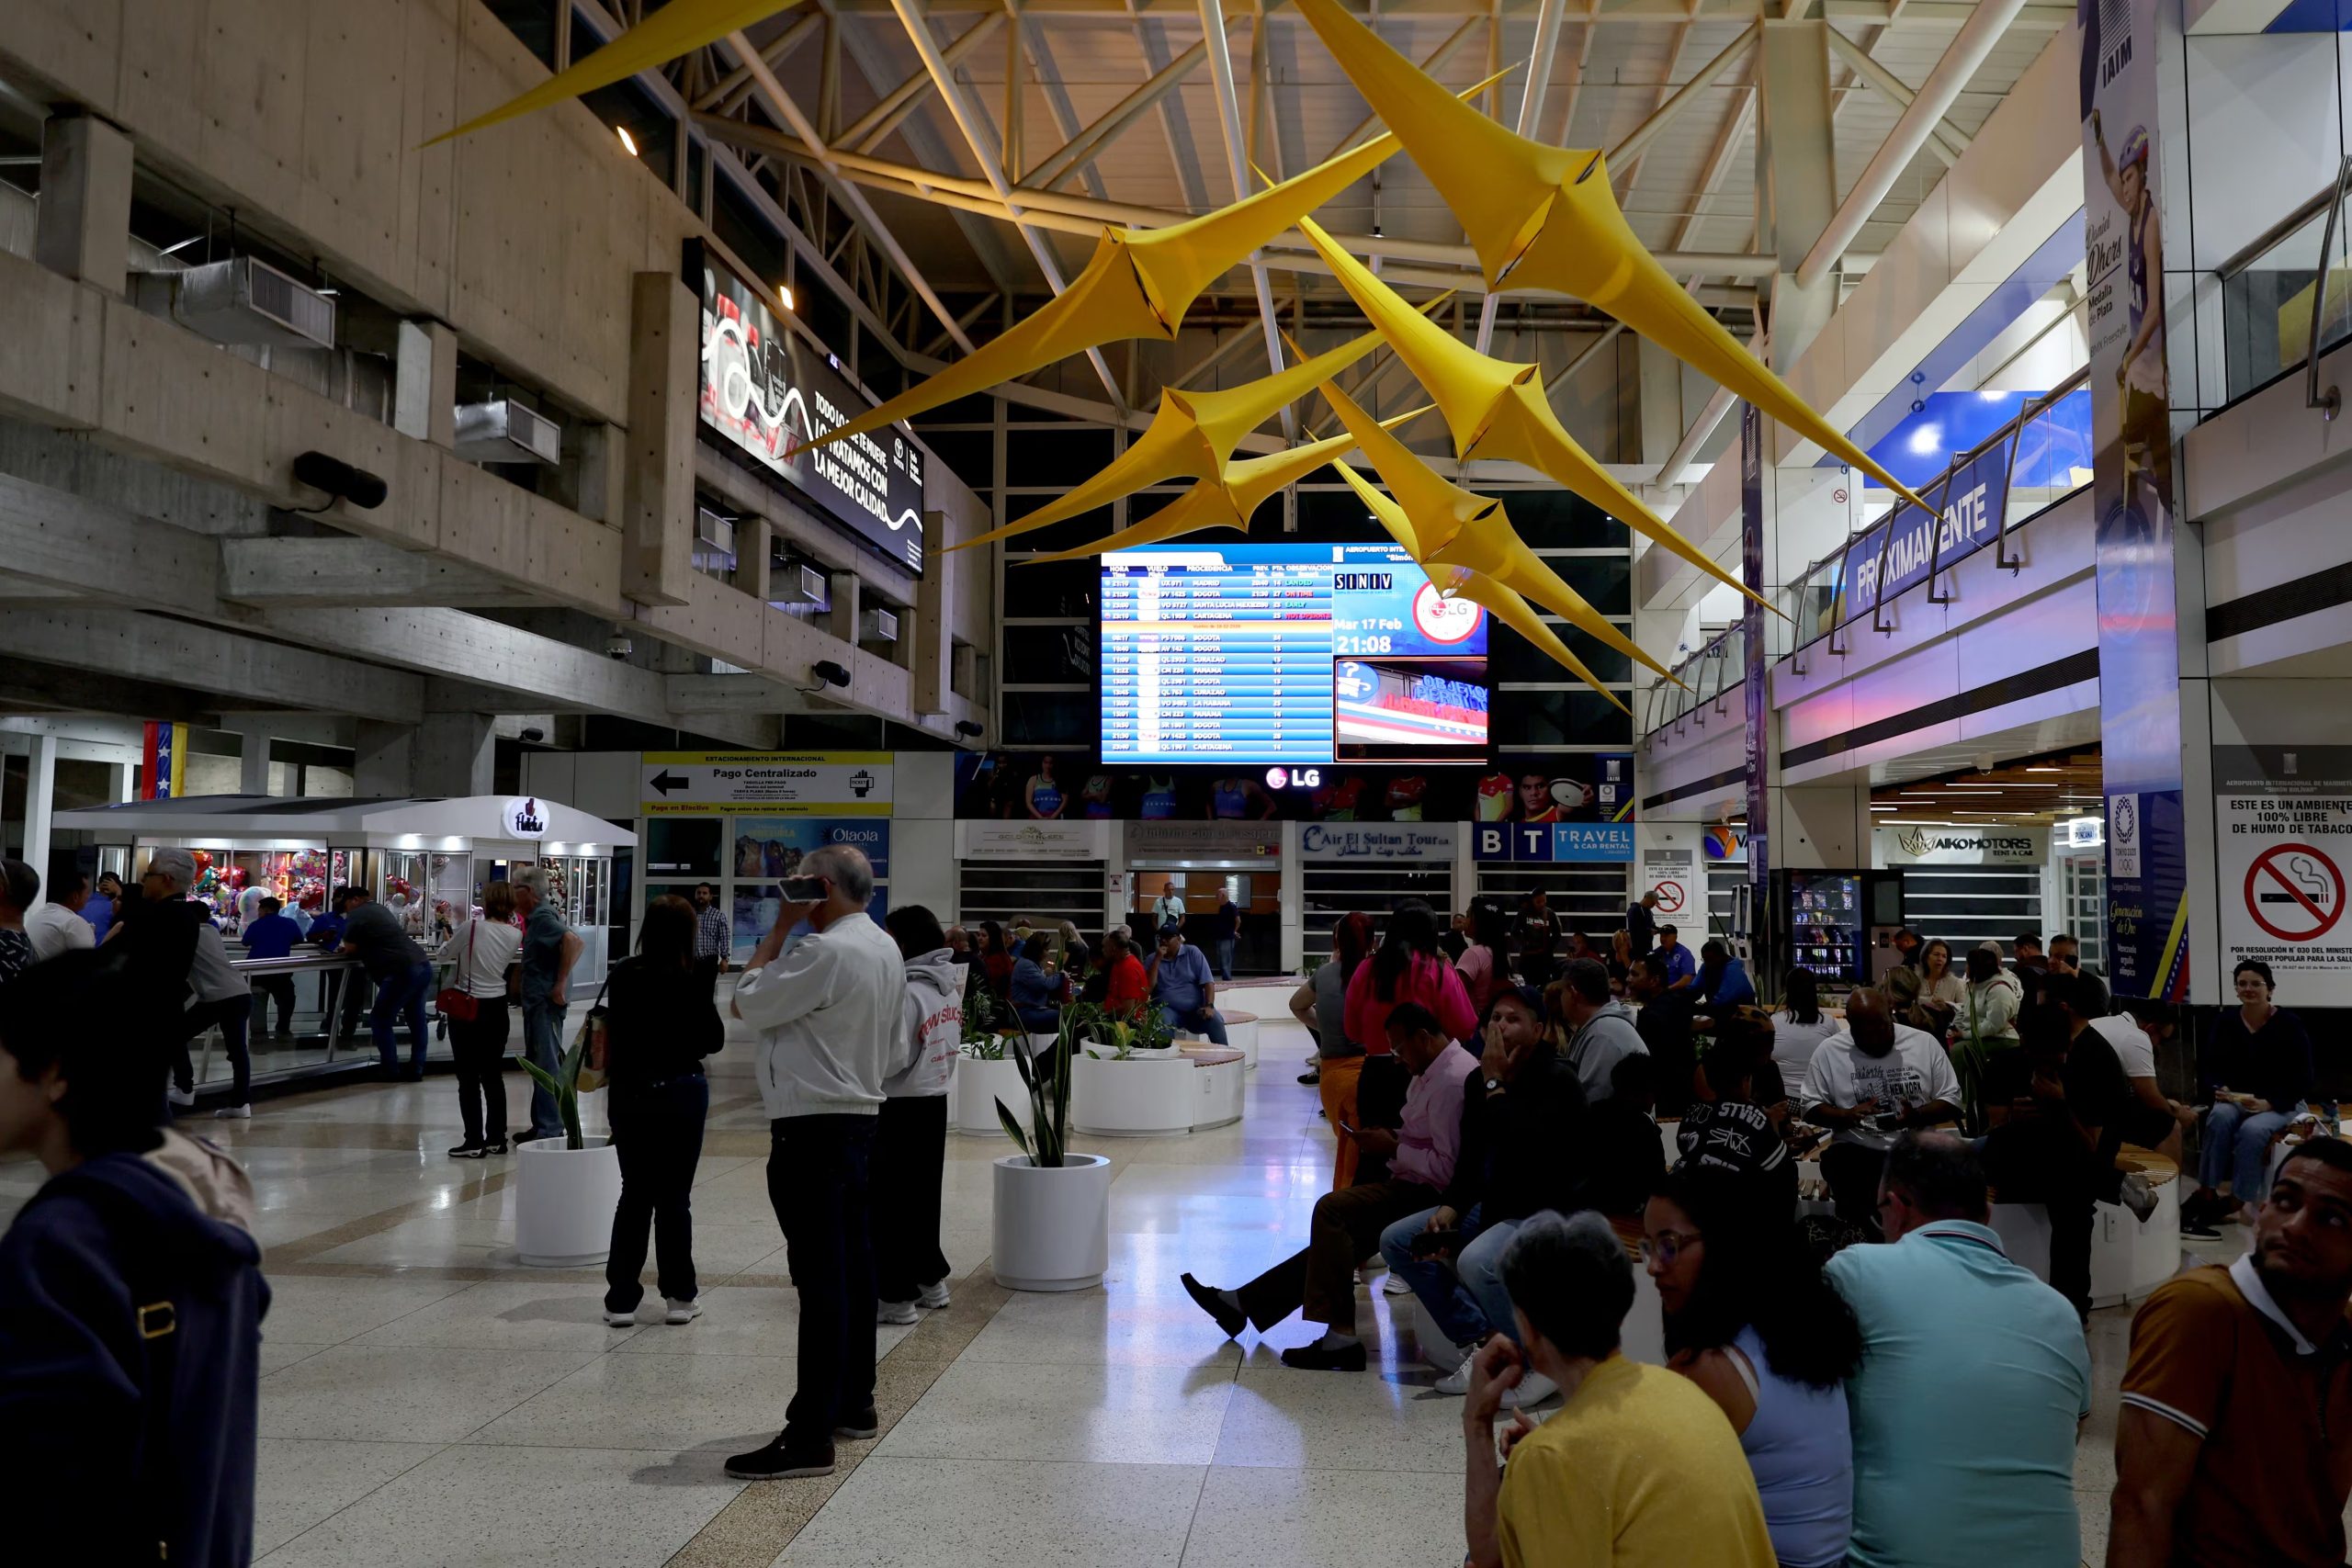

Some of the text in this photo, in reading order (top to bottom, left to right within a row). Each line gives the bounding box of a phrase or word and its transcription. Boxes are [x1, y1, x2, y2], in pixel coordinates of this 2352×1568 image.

[2102, 35, 2132, 88] IAIM
[2088, 285, 2112, 310] Medalla
[2088, 301, 2112, 326] de Plata
[2103, 323, 2127, 345] Freestyle
[815, 390, 835, 423] TODO
[829, 430, 870, 483] TRATAMOS
[871, 467, 888, 498] CON
[866, 438, 888, 473] MUEVE,
[812, 448, 888, 523] LA MEJOR CALIDAD
[1857, 482, 1987, 602] PRÓXIMAMENTE
[1336, 574, 1392, 589] SINIV
[1448, 603, 1467, 615] LG
[1333, 618, 1402, 630] Mar 17 Feb
[1337, 636, 1392, 653] 21:08
[1423, 675, 1487, 698] OBJETO
[713, 768, 817, 779] Pago Centralizado
[1292, 769, 1320, 787] LG
[2231, 800, 2352, 809] ESTE ES UN AMBIENTE
[2257, 812, 2327, 821] 100% LIBRE
[832, 828, 878, 842] Olaola
[1321, 833, 1439, 844] Air El Sultan Tour
[1558, 830, 1630, 842] TRAVEL
[2233, 824, 2352, 833] DE HUMO DE TABACO
[1482, 830, 1543, 853] B T
[2109, 900, 2143, 922] Generación
[1890, 1081, 1922, 1097] NEW YORK
[1717, 1102, 1768, 1131] STWD
